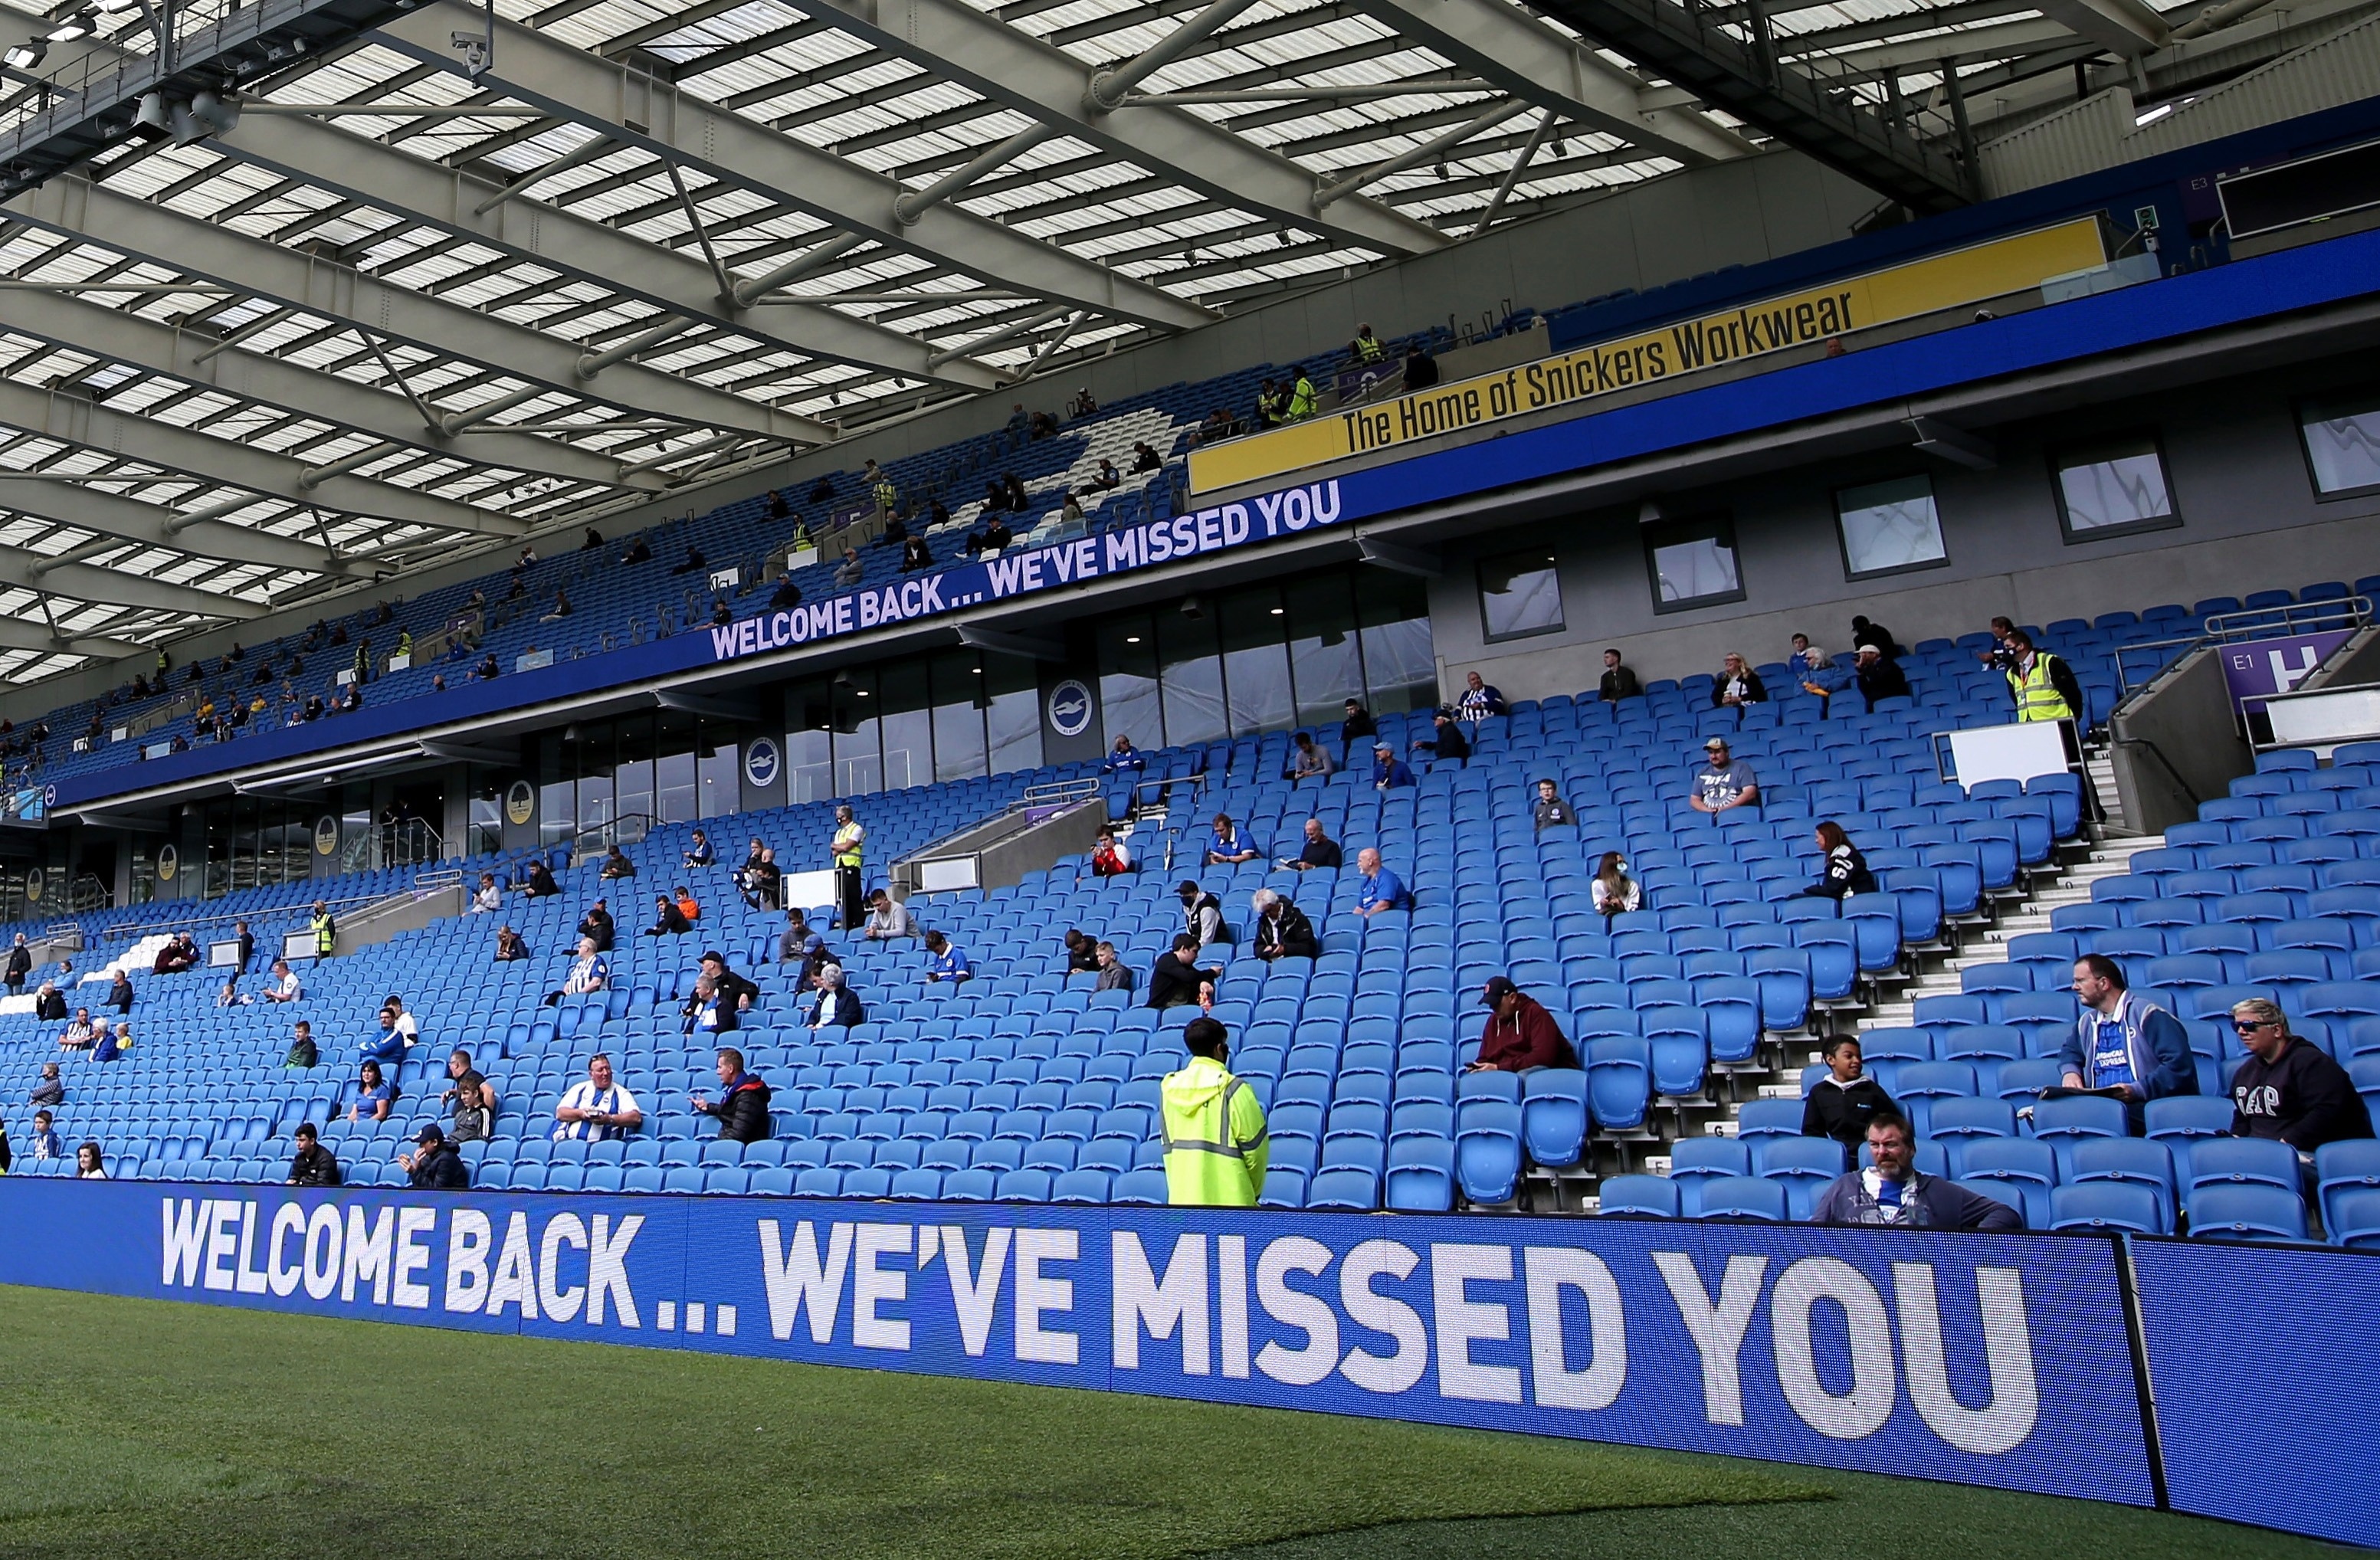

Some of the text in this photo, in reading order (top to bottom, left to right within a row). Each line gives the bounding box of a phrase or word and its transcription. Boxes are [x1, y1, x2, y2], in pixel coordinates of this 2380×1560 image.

[2191, 177, 2208, 190] E3
[1342, 291, 1851, 452] The Home of Snickers Workwear
[711, 595, 853, 660] WELCOME
[985, 537, 1099, 598] WE'VE
[1105, 503, 1249, 572] MISSED
[1254, 479, 1340, 536] YOU
[2233, 654, 2254, 670] E1
[2267, 645, 2318, 693] H
[2097, 854, 2105, 864] P
[2029, 906, 2038, 916] N
[1992, 934, 2002, 944] M
[1714, 1126, 1723, 1137] G
[1655, 1161, 1663, 1174] F
[161, 1197, 437, 1309] WELCOME
[757, 1219, 1080, 1365] WE'VE
[1111, 1231, 1628, 1411] MISSED
[1651, 1252, 2040, 1454] YOU
